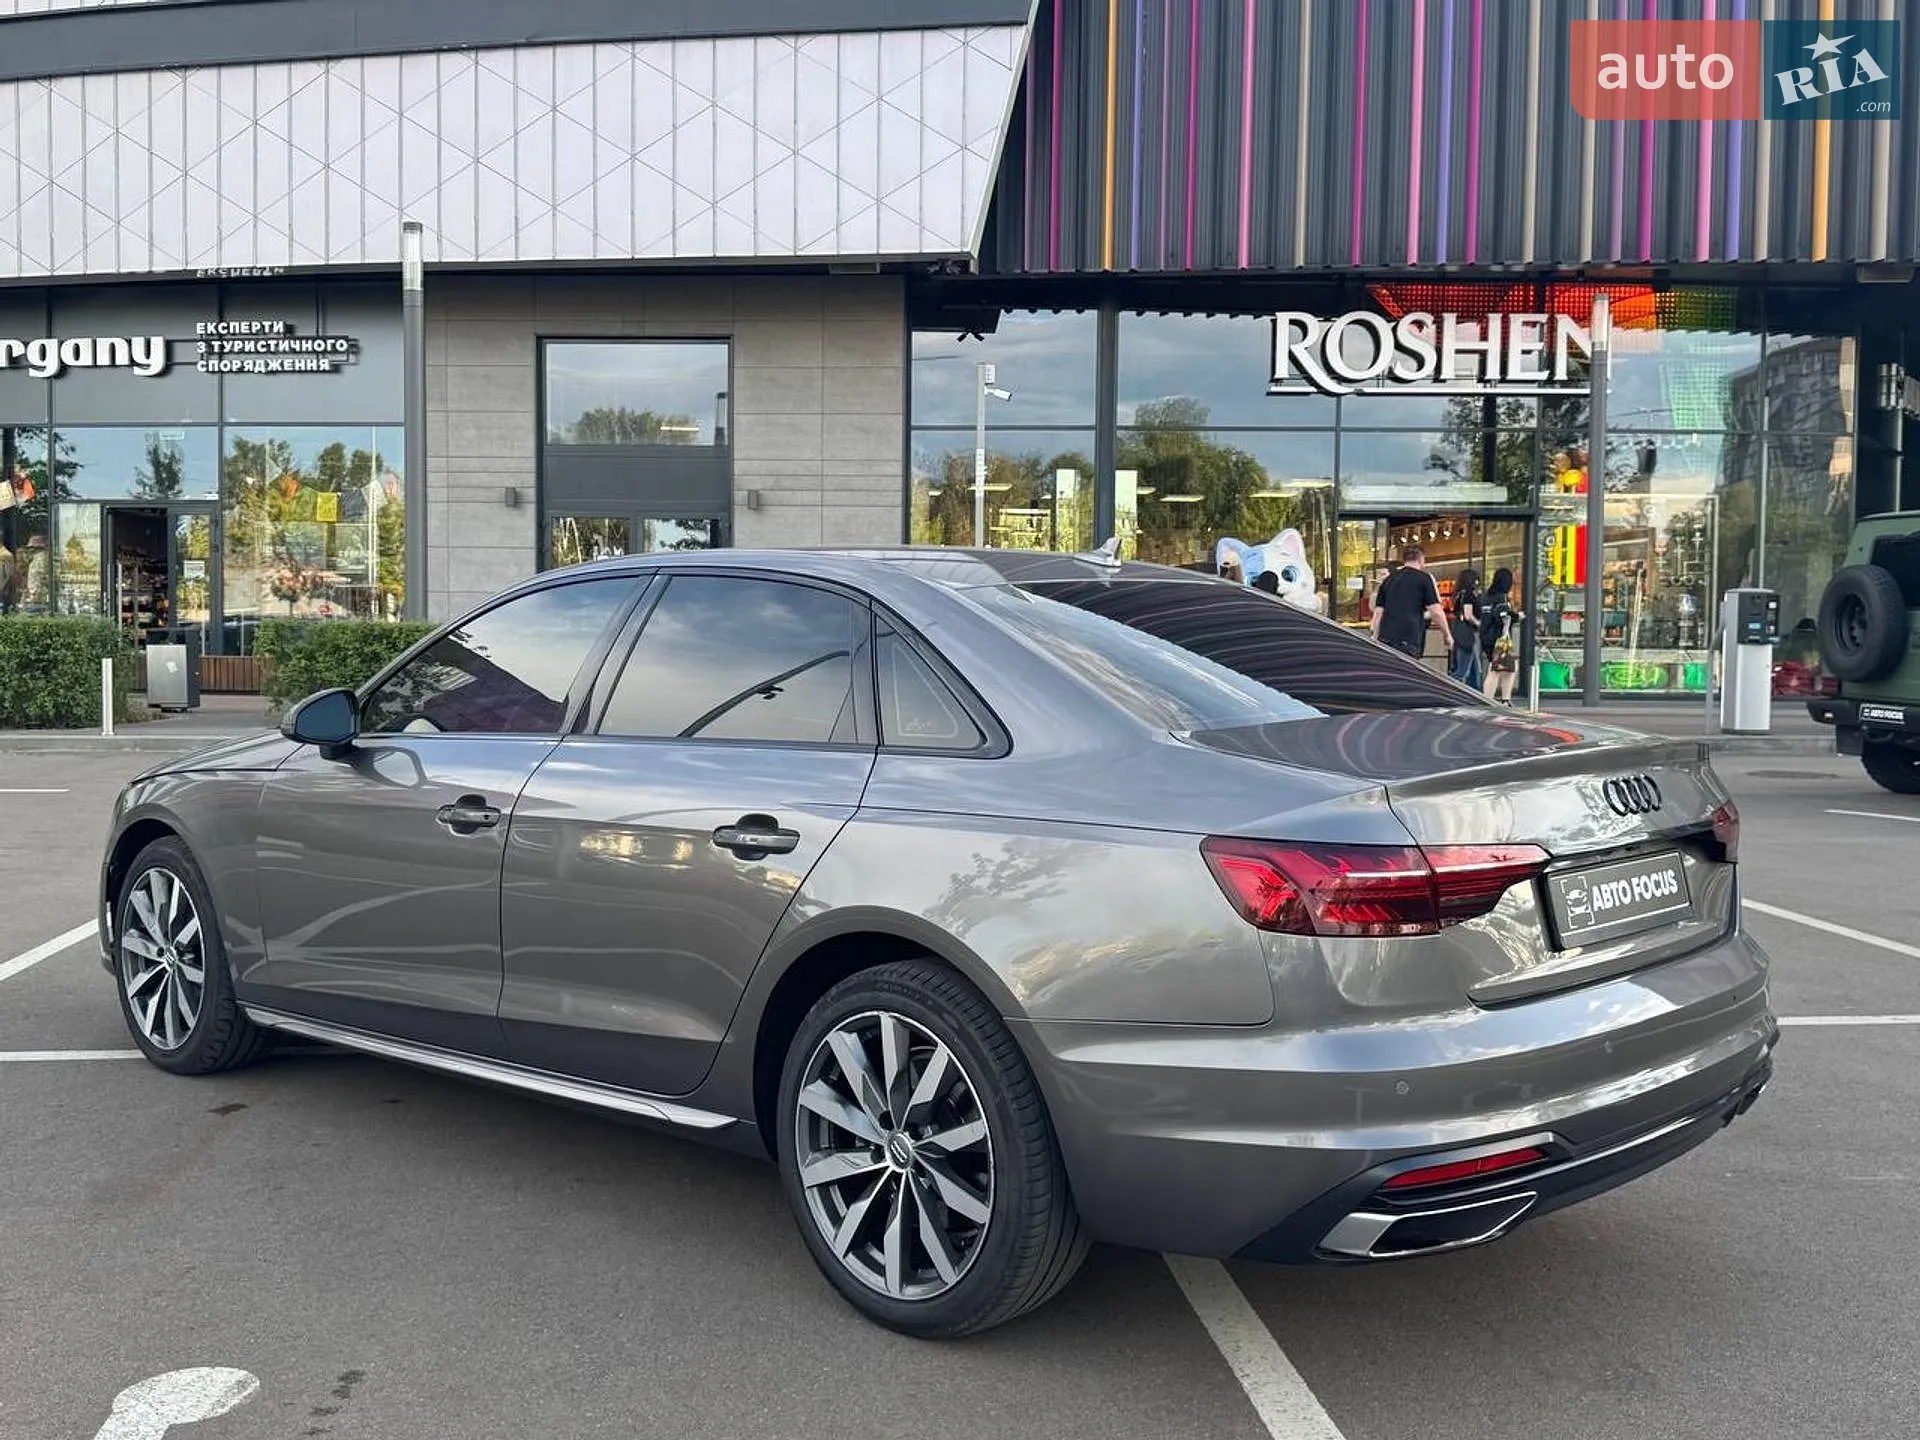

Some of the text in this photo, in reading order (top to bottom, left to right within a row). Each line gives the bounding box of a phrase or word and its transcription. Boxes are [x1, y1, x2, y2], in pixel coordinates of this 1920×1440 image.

[196, 320, 284, 335] ЕКСПЕРТИ
[212, 338, 348, 353] ТУРИСТИЧНОГО
[1273, 311, 1611, 394] ROSHEN
[196, 359, 330, 373] СПОРЯДЖЕННЯ
[1631, 869, 1678, 902] FOCUS
